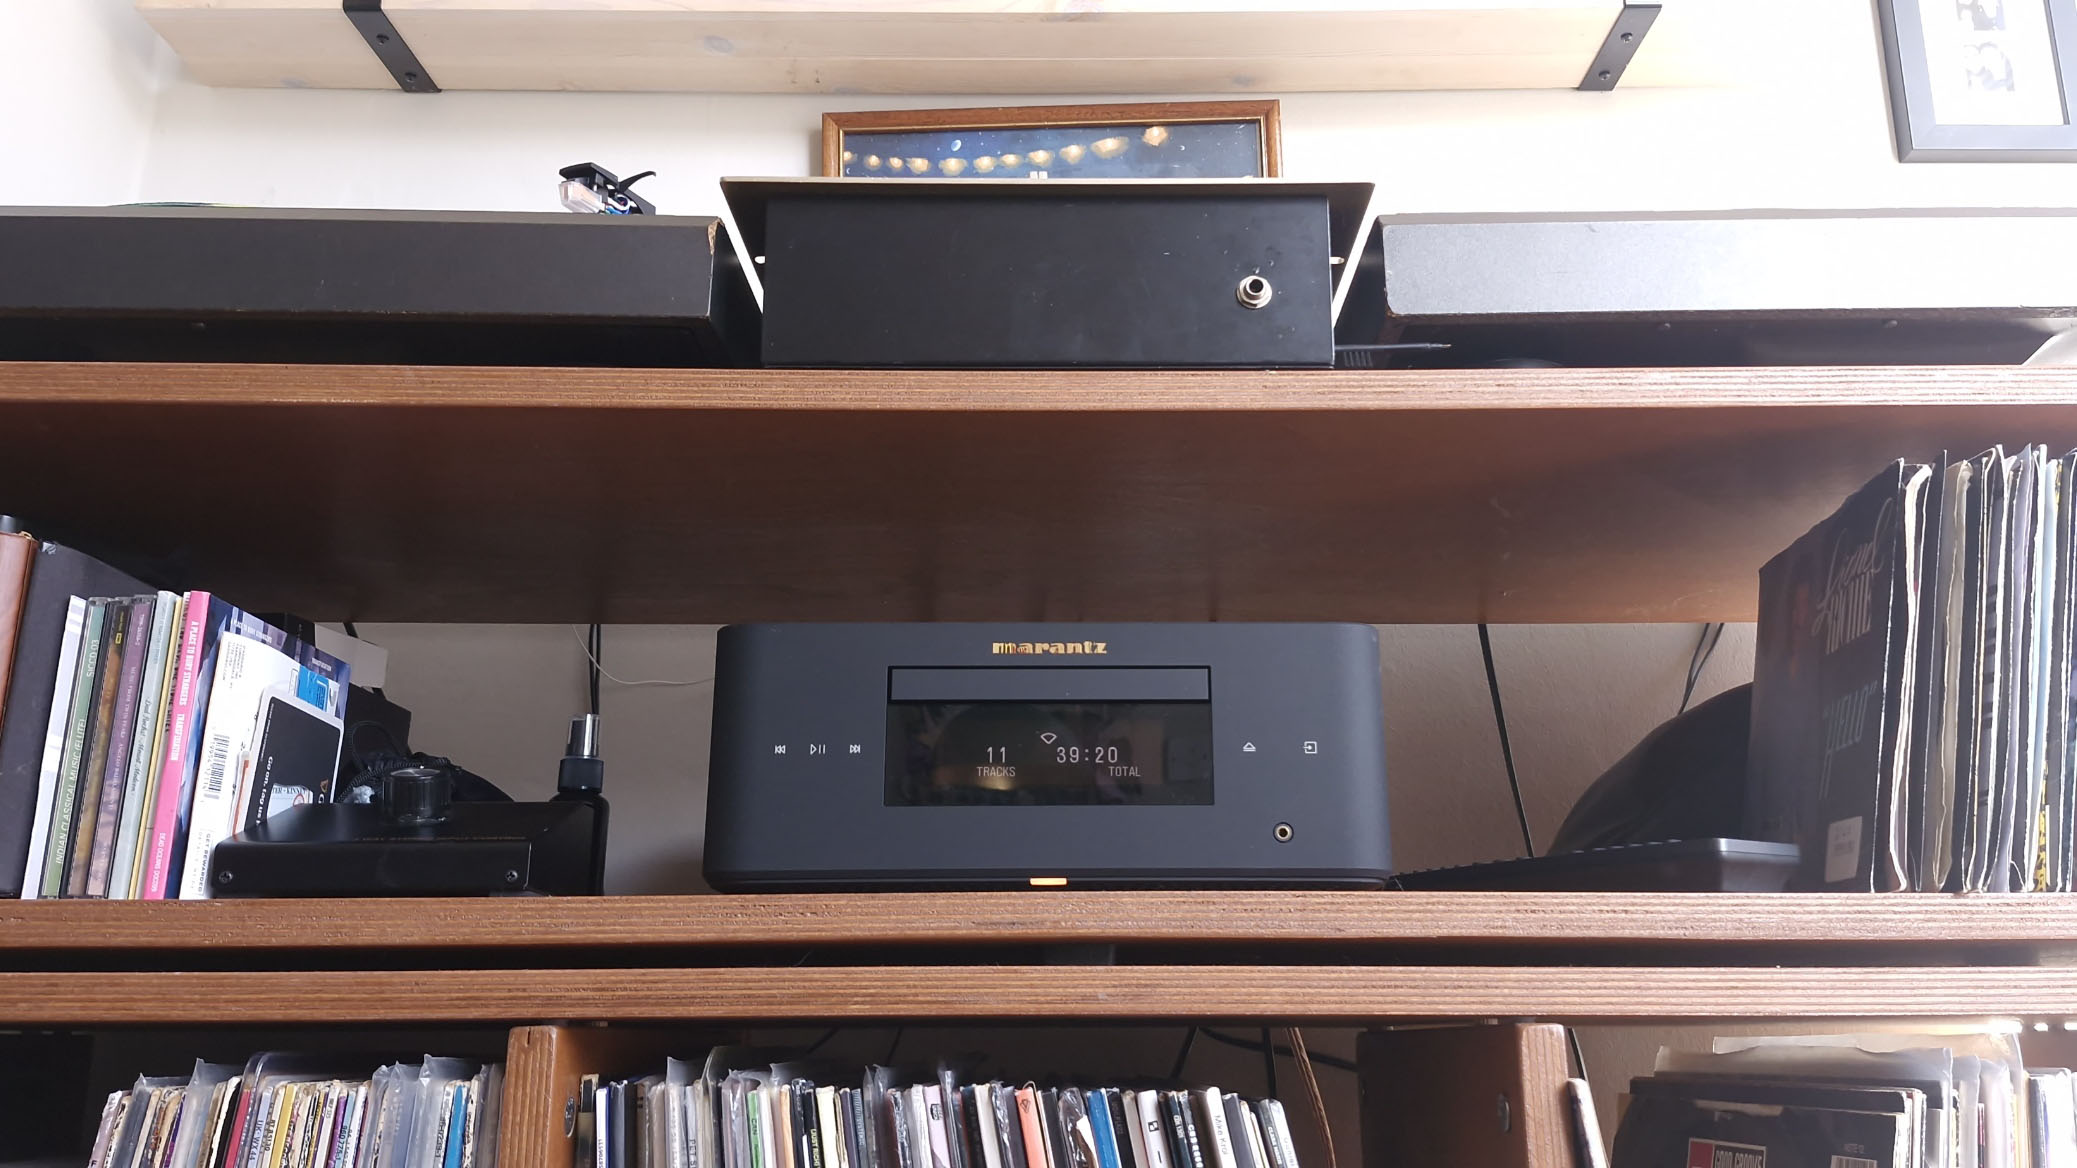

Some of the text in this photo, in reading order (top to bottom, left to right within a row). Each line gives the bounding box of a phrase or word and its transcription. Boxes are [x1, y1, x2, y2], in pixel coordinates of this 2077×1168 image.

[188, 626, 198, 646] PLACE
[186, 646, 195, 654] TO
[992, 641, 1108, 654] marantz
[178, 671, 191, 706] STRANGERS
[266, 755, 273, 770] Go
[986, 746, 1006, 763] 11
[1056, 746, 1118, 763] 39:20
[70, 750, 81, 780] MUSIC
[977, 766, 1016, 777] TRACKS
[1108, 766, 1141, 777] TOTAL
[258, 788, 266, 804] tag
[61, 783, 75, 832] CLASSICAL
[256, 806, 263, 818] us
[56, 832, 67, 863] INDIAN
[198, 849, 208, 892] REWARDED
[1213, 1114, 1224, 1135] Mike
[688, 1138, 696, 1156] PET
